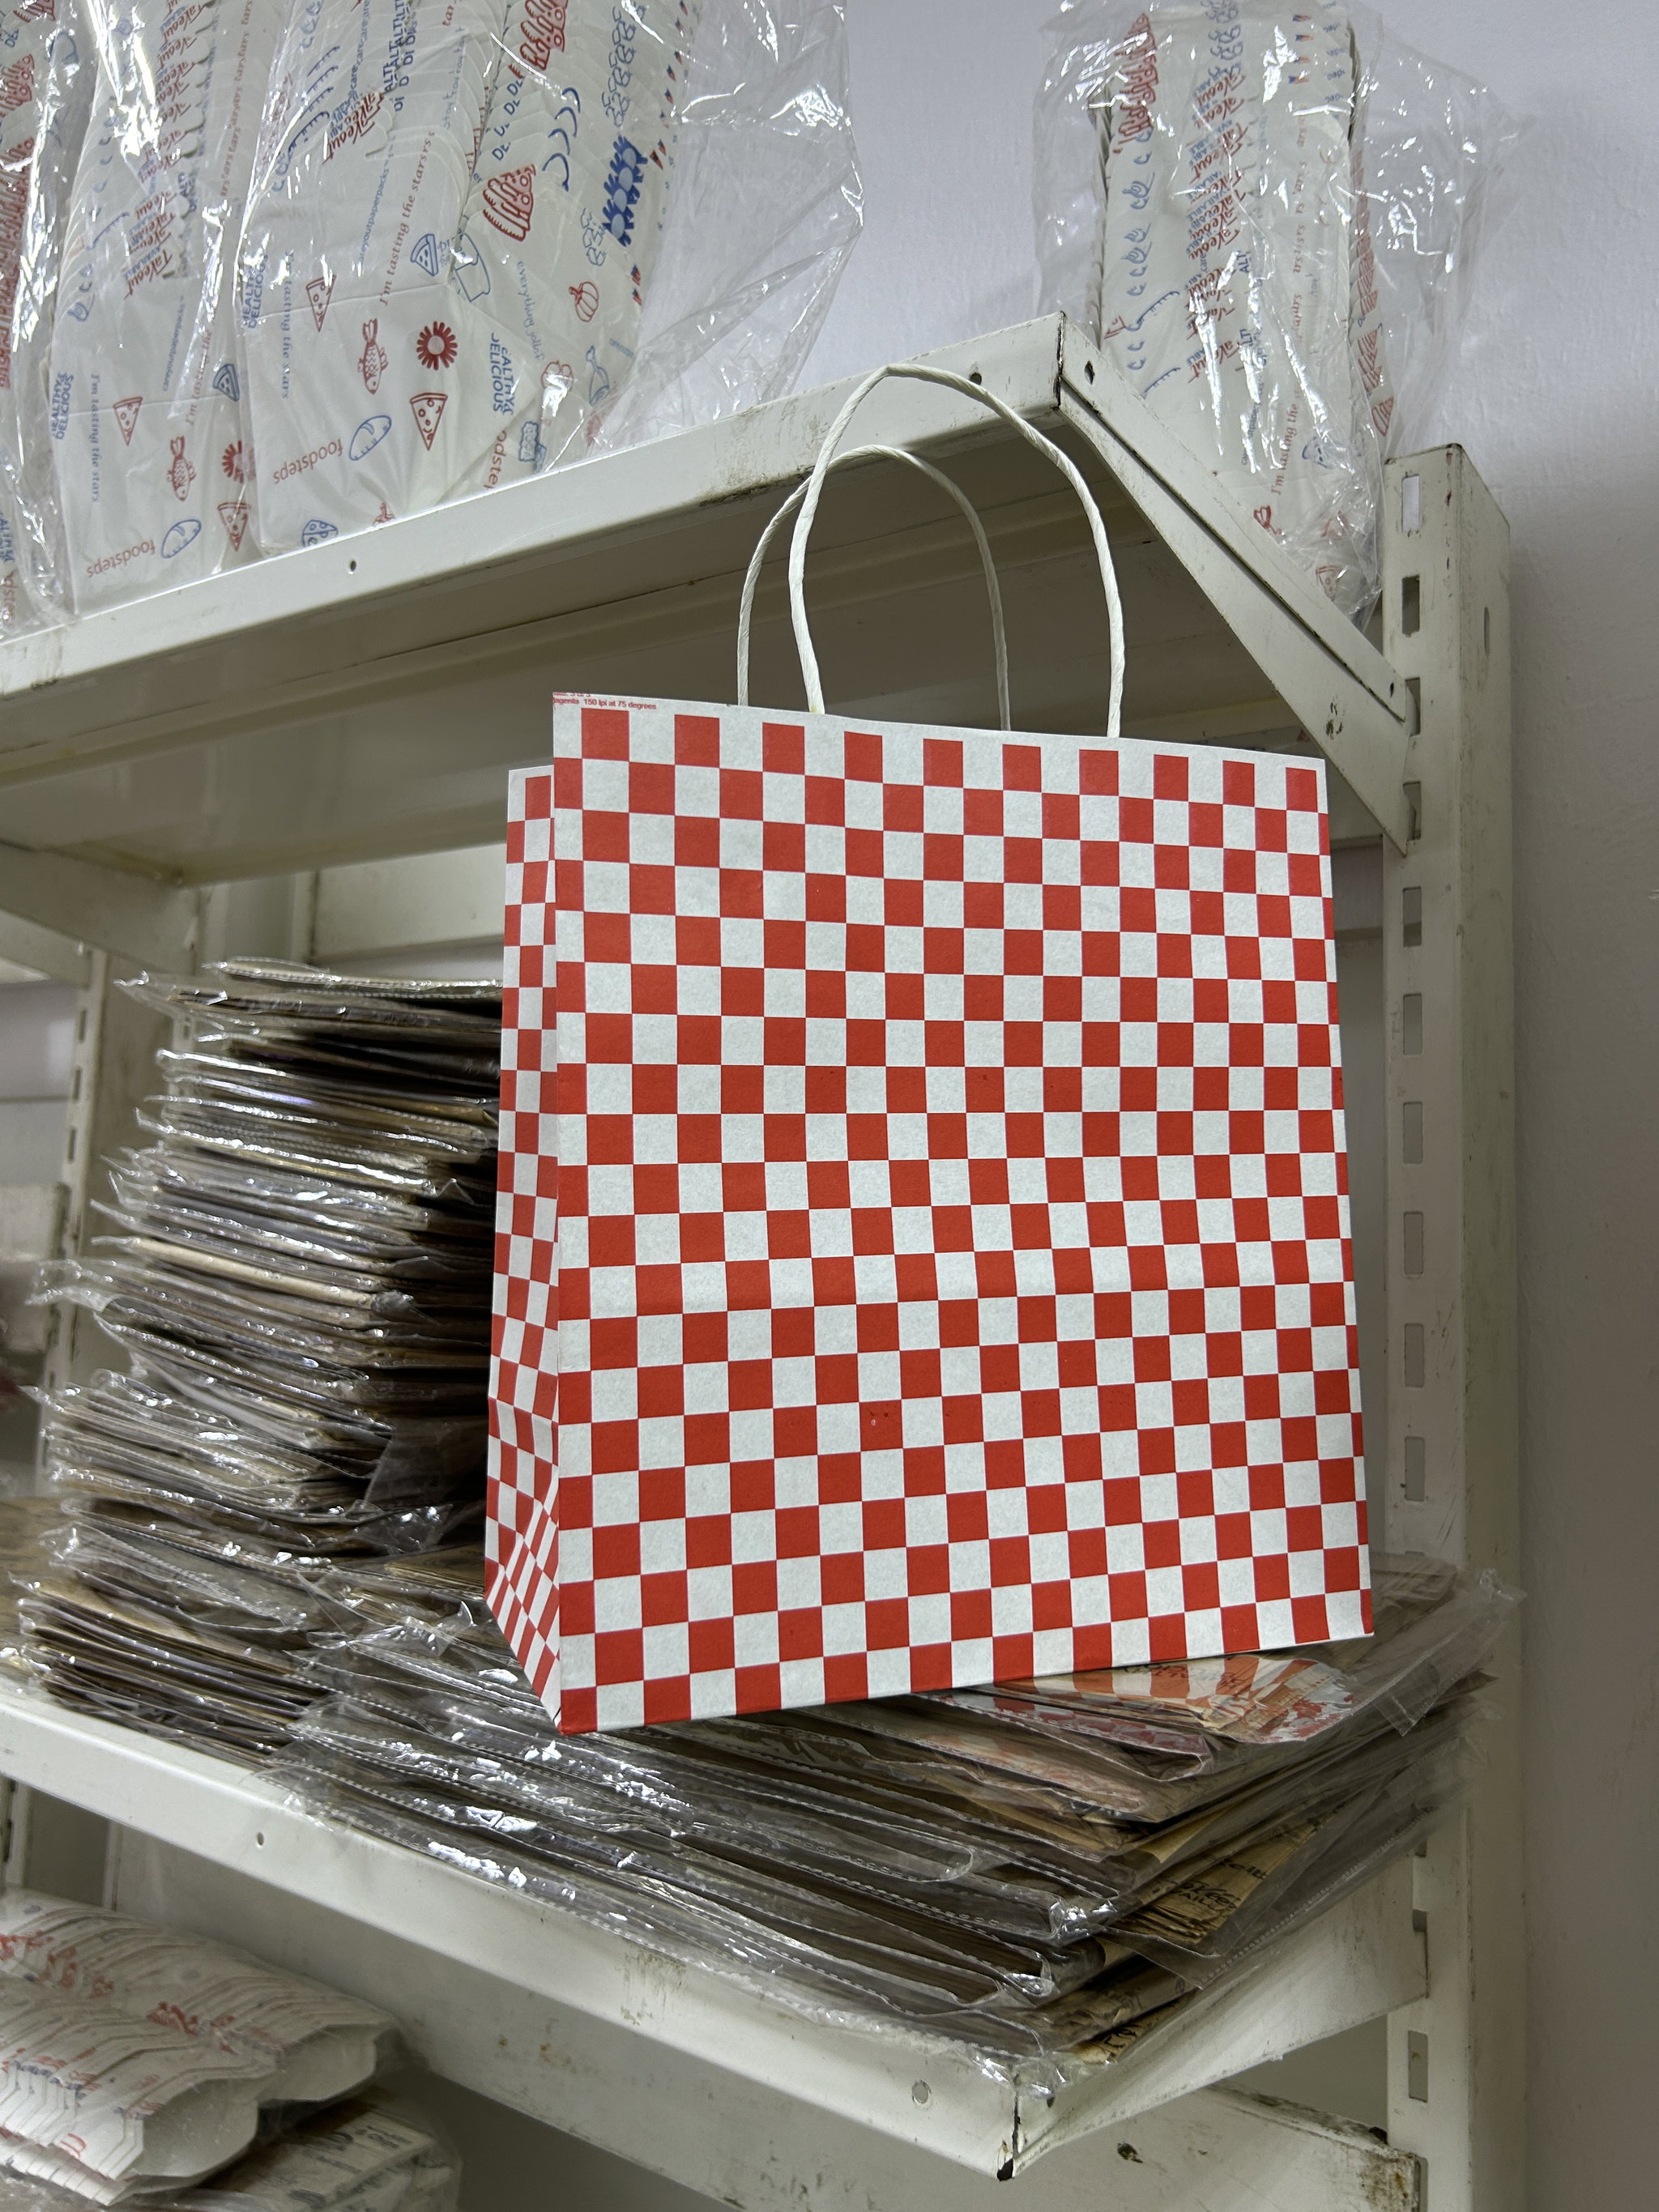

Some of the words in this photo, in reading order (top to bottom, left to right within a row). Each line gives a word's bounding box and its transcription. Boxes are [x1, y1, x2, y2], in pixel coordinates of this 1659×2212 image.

[387, 221, 411, 276] tasting
[402, 194, 416, 219] the
[516, 260, 535, 328] everything
[273, 438, 343, 484] foodsteps
[87, 539, 156, 578] foodsteps
[583, 698, 597, 706] 150
